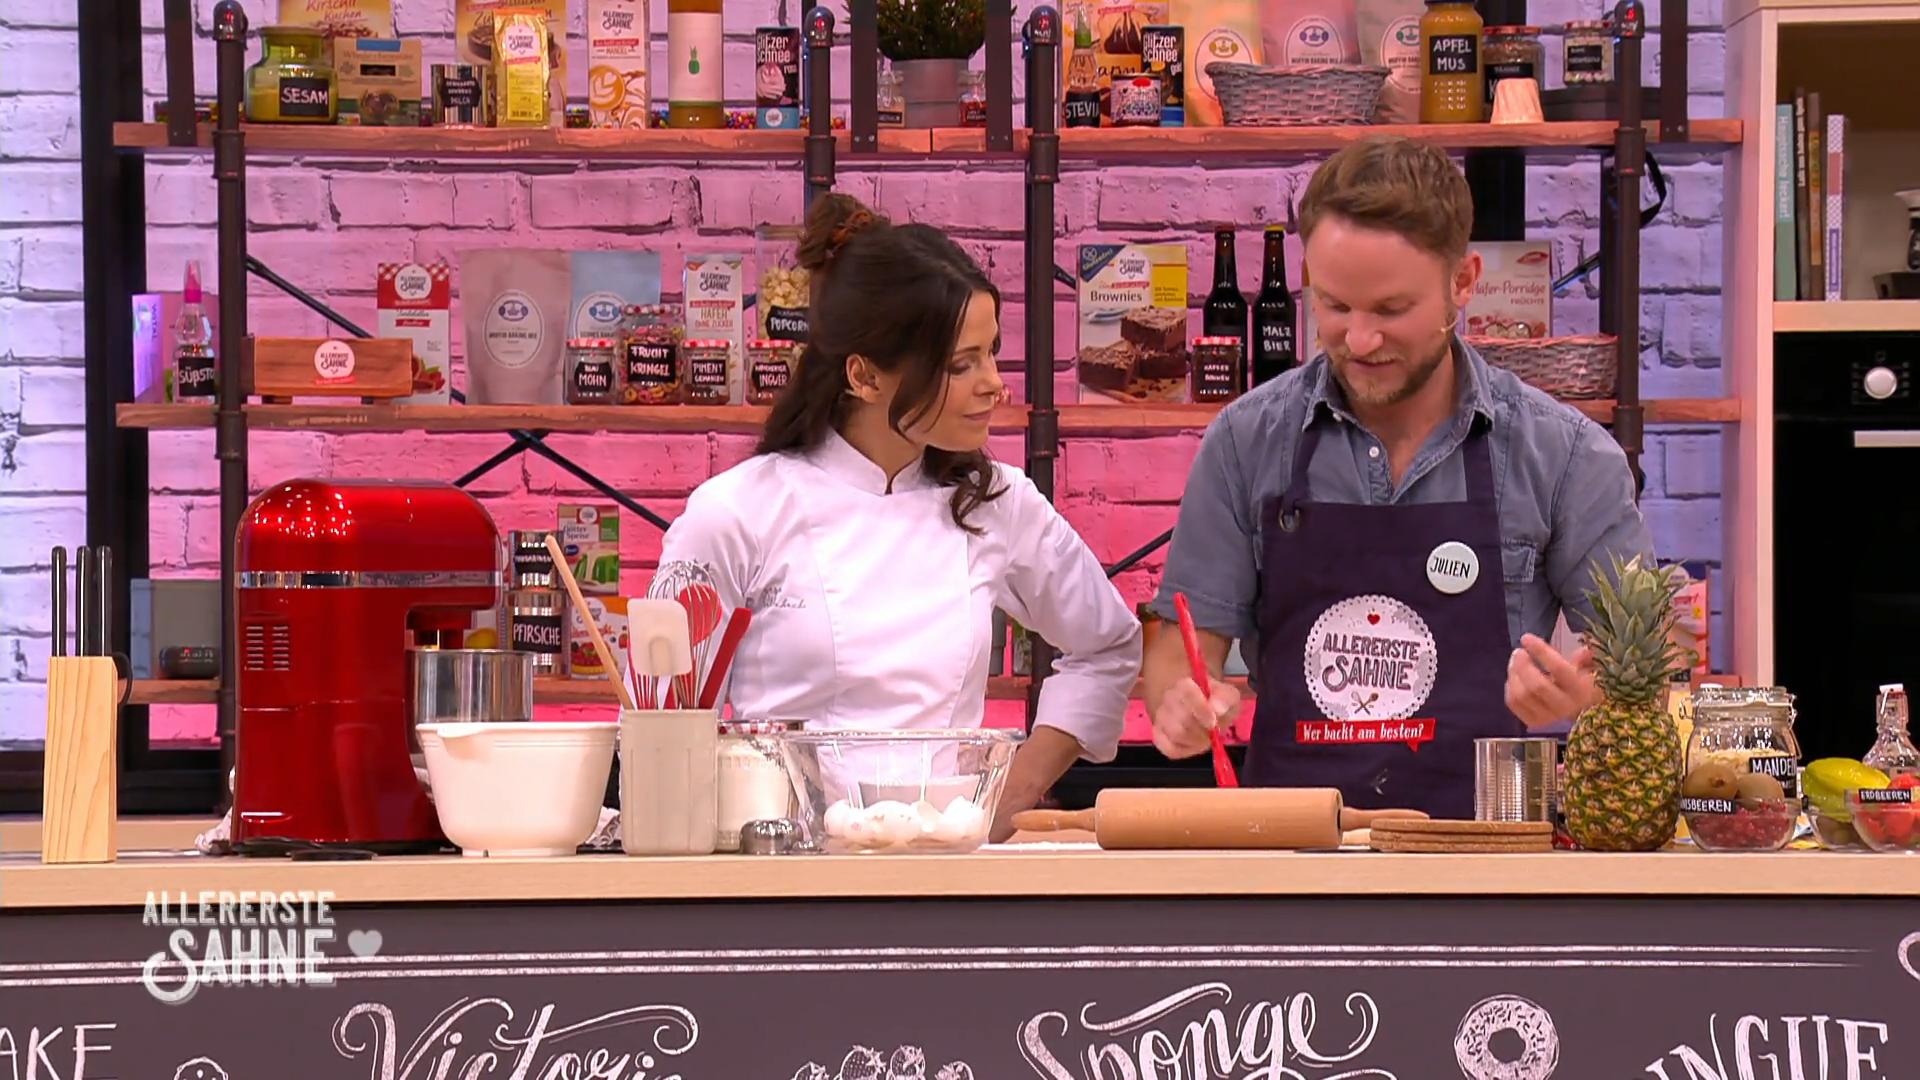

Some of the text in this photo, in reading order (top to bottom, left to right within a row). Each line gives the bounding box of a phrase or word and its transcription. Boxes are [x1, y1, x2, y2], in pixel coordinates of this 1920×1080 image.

[1433, 38, 1472, 53] APFEL
[1437, 57, 1466, 71] MUS
[281, 86, 328, 105] SESAM
[1090, 291, 1142, 302] Brownies
[1262, 325, 1291, 337] MALZ
[1263, 340, 1291, 352] BIER
[630, 361, 670, 376] KRINGEL
[692, 362, 724, 374] PIMENT
[578, 374, 607, 387] MOHN
[759, 374, 788, 388] INGWER
[1430, 557, 1470, 579] JULIEN
[513, 624, 561, 646] PFIRSICHE
[1323, 633, 1421, 661] ALLERERSTE
[1322, 655, 1413, 692] SAHNE
[1303, 723, 1321, 741] Wer
[1358, 728, 1376, 740] am
[1381, 722, 1424, 740] besten?
[1861, 790, 1910, 801] ERDBEEREN
